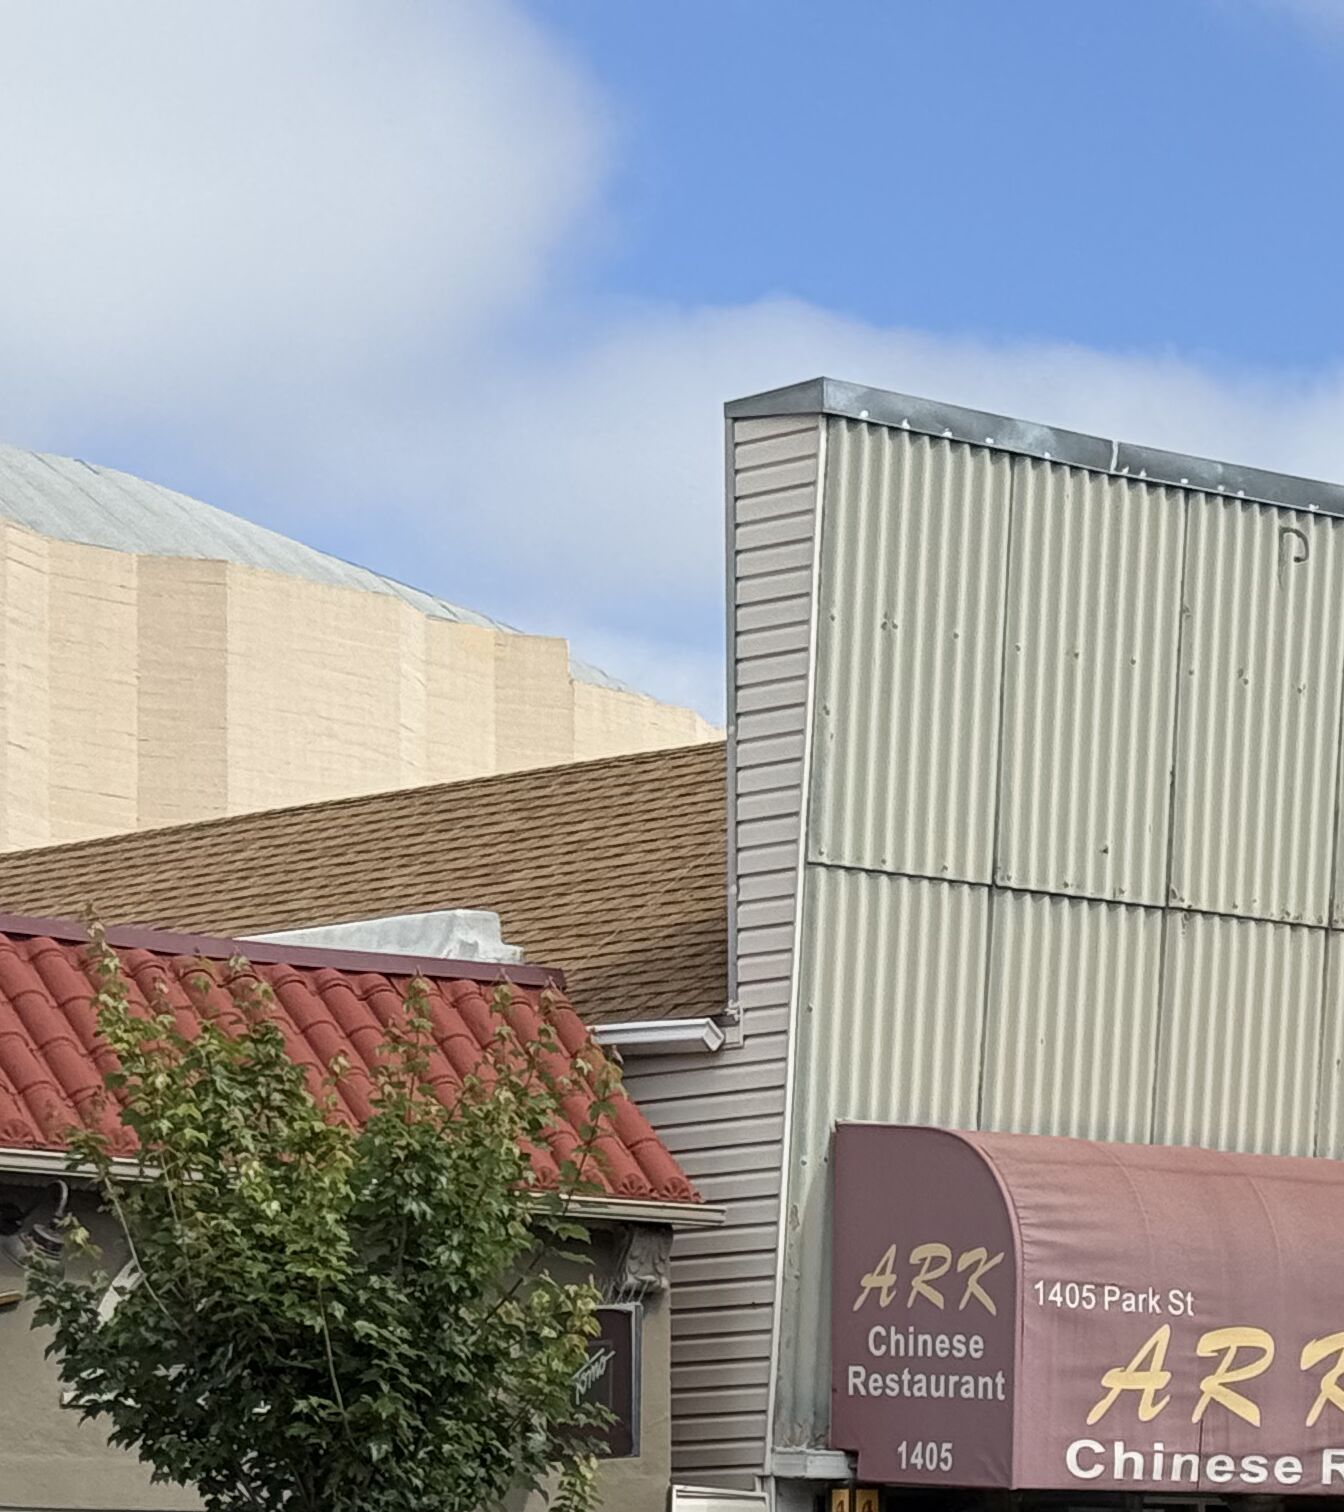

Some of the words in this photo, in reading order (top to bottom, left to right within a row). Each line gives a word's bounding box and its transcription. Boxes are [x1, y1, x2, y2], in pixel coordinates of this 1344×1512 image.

[853, 1243, 1004, 1316] ARK
[1034, 1280, 1096, 1310] 1405
[1104, 1285, 1162, 1316] Park
[1168, 1289, 1195, 1317] St
[868, 1325, 984, 1359] Chinese
[848, 1366, 1006, 1401] Restaurant
[897, 1440, 953, 1471] 1405
[1066, 1439, 1303, 1485] Chinese
